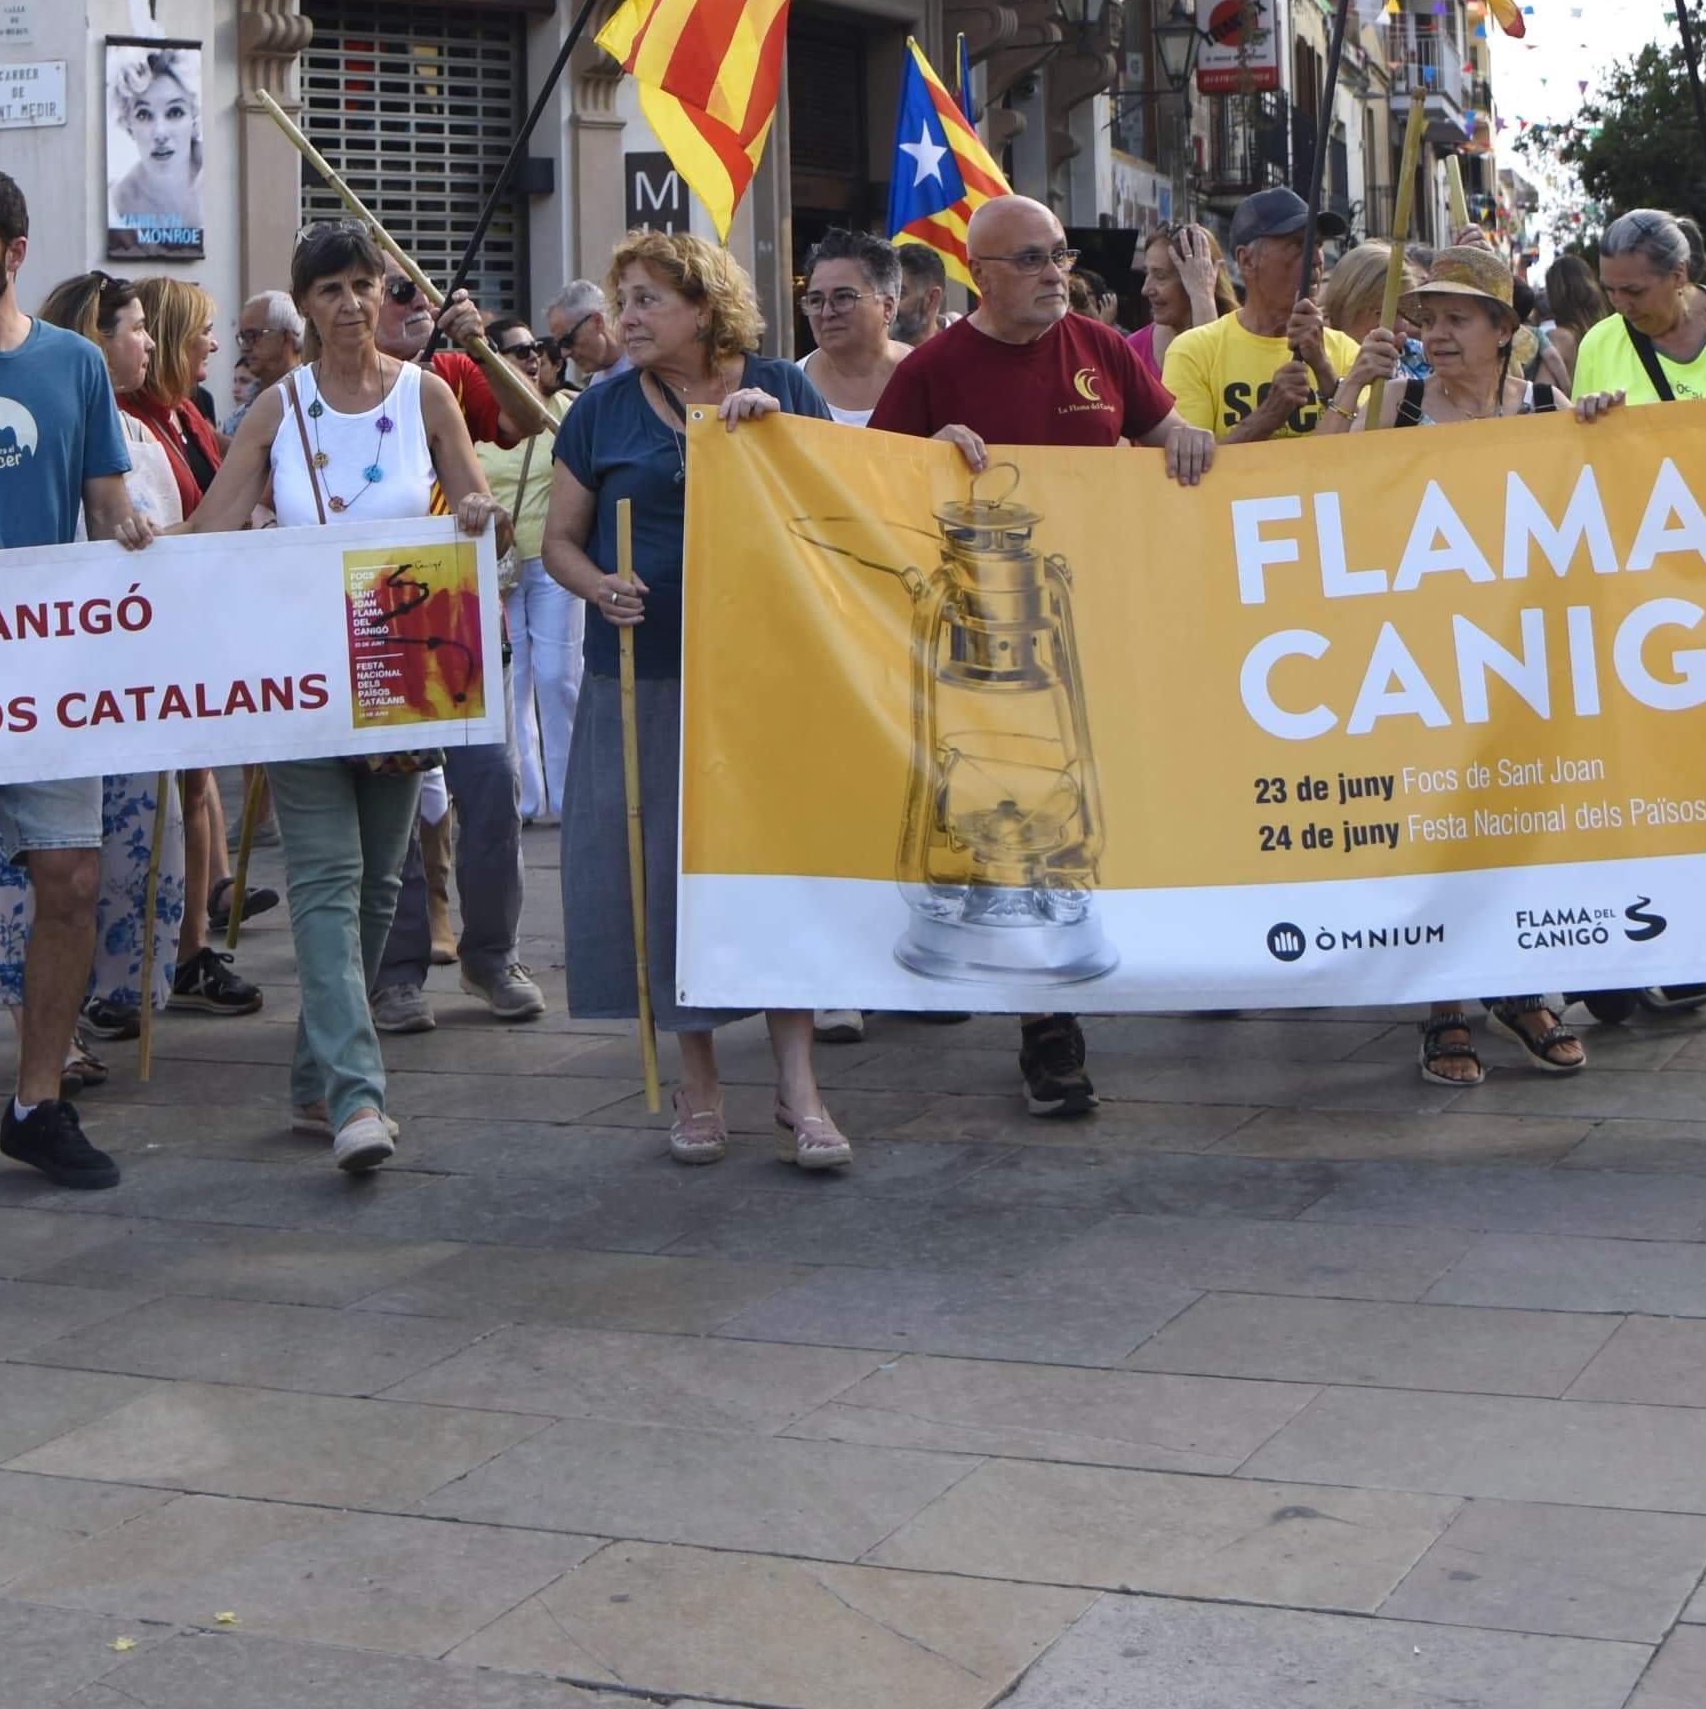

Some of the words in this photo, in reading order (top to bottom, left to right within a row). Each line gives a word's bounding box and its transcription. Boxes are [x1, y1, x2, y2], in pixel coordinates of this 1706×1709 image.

[11, 86, 25, 99] DE
[21, 102, 56, 118] MEDIR
[137, 228, 200, 245] MONROE
[350, 572, 374, 580] FOCS
[351, 582, 363, 590] DE
[351, 590, 375, 599] SANT
[352, 599, 377, 608] JOAN
[353, 608, 384, 617] FLAMA
[353, 618, 371, 627] DEL
[354, 625, 389, 636] CANIGÓ
[356, 662, 384, 671] FESTA
[357, 669, 402, 680] NACIONAL
[358, 679, 380, 689] DELS
[358, 687, 390, 698] PAÏSOS
[56, 672, 330, 727] CATALANS
[359, 695, 405, 708] CATALANS
[1254, 777, 1288, 804] 23
[1295, 773, 1329, 803] de
[1337, 771, 1394, 805] juny
[1402, 765, 1458, 794] Focs
[1465, 761, 1491, 789] de
[1497, 758, 1544, 788] Sant
[1549, 755, 1605, 785] Joan
[1258, 824, 1292, 852] 24
[1300, 821, 1334, 850] de
[1342, 819, 1399, 853] juny
[1407, 813, 1468, 842] Festa
[1474, 804, 1566, 839] Nacional
[1574, 802, 1623, 830] dels
[1629, 797, 1706, 827] Països
[1516, 907, 1592, 929] FLAMA
[1594, 909, 1615, 919] DEL
[1315, 924, 1445, 951] ÒMNIUM
[1517, 922, 1609, 950] CANIGÓ
